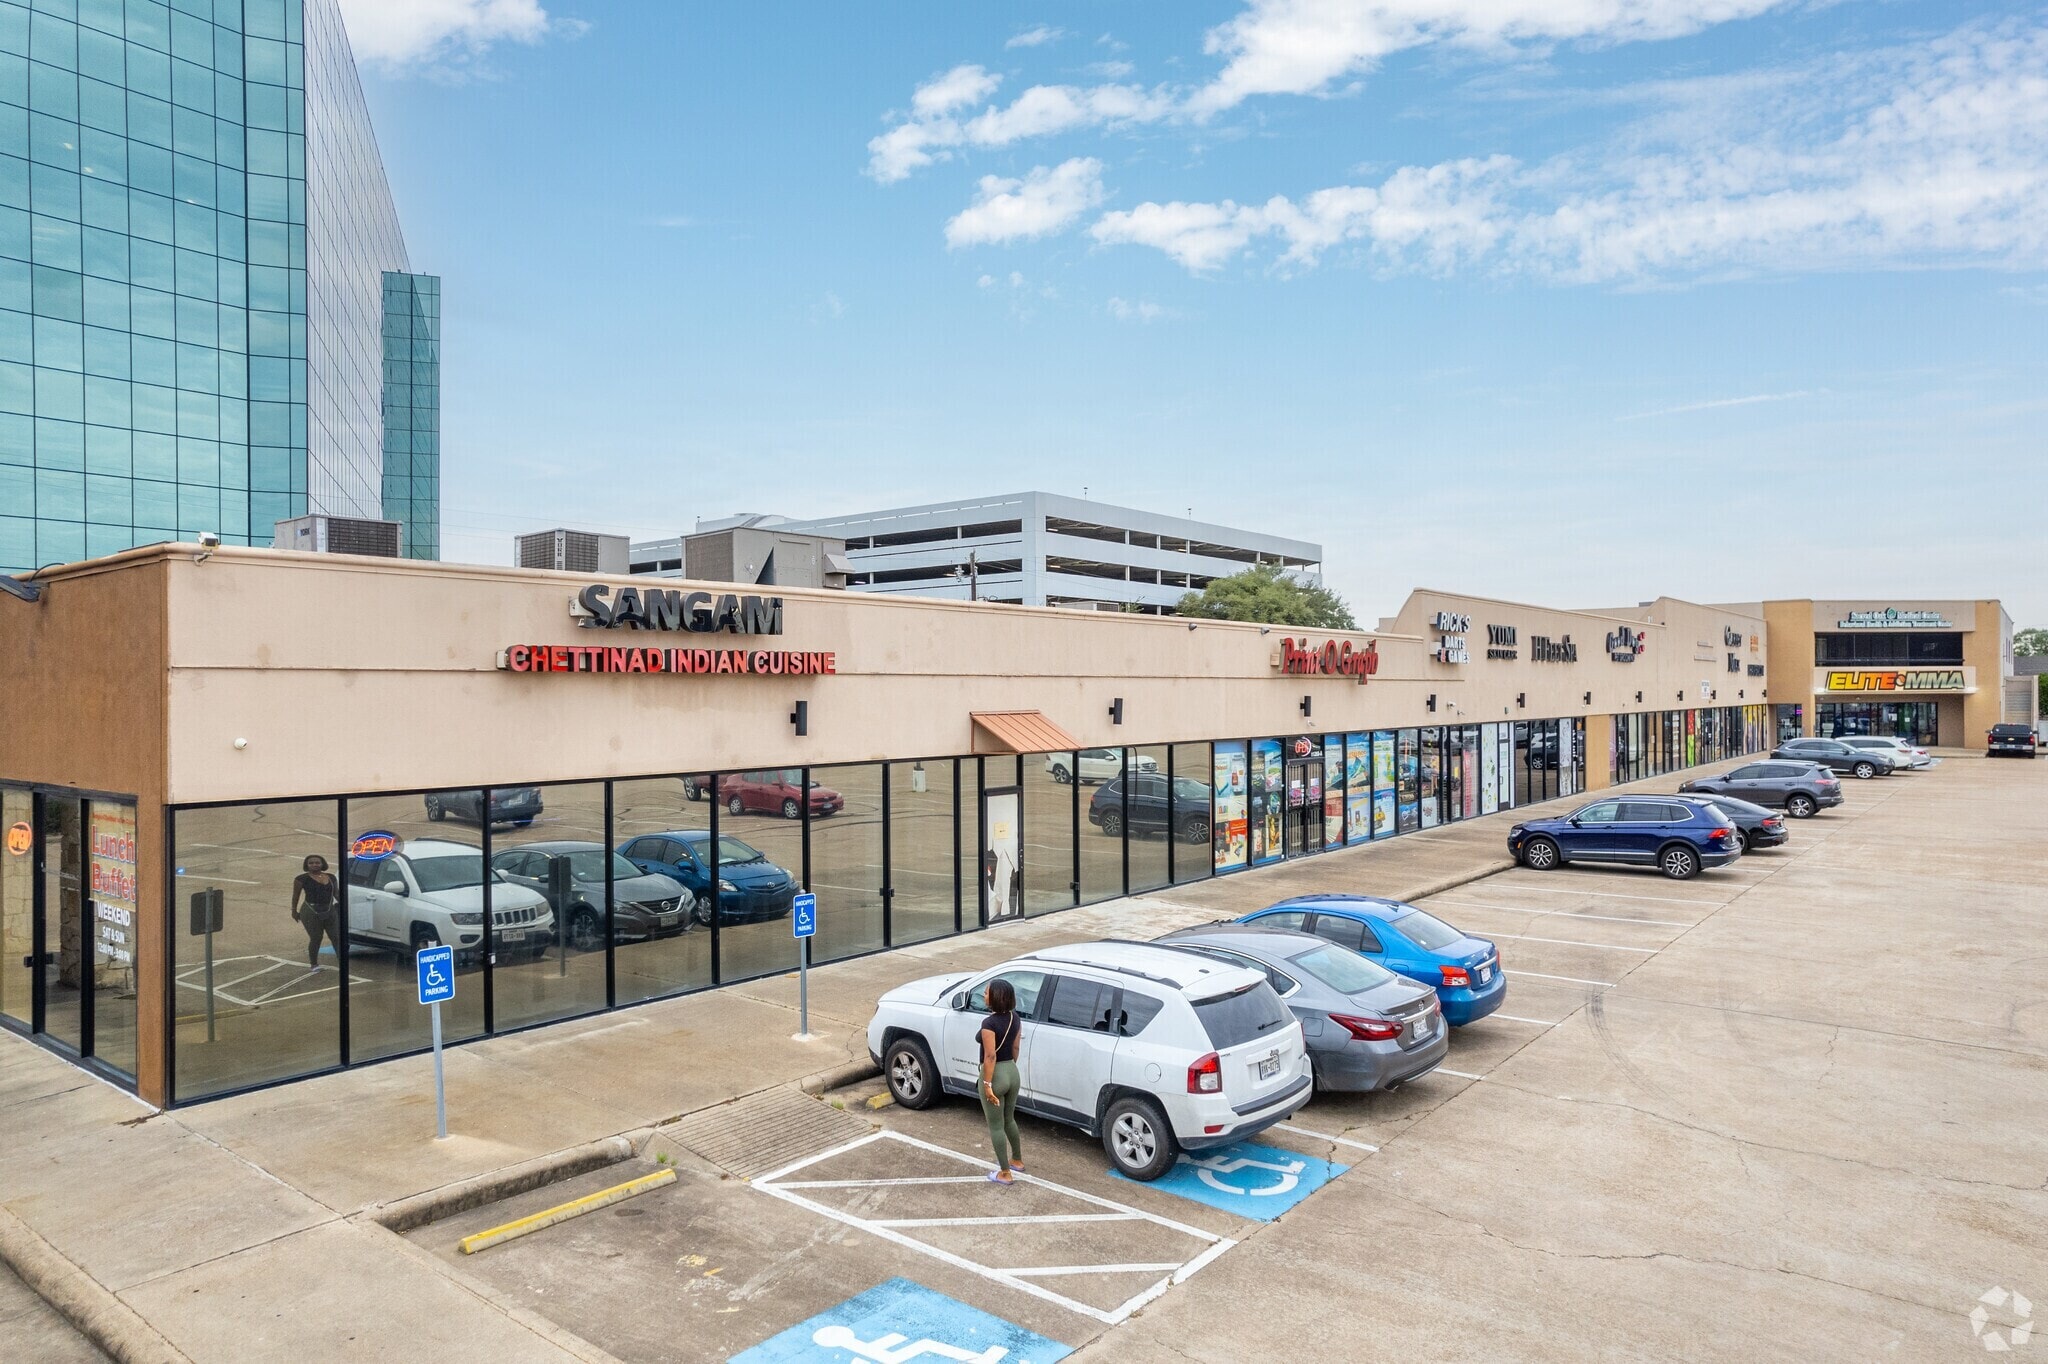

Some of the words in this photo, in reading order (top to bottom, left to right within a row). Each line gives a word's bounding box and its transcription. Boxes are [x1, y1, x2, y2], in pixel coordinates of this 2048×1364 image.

[578, 584, 783, 635] SANGAM
[1443, 635, 1466, 649] DARTS
[1487, 624, 1517, 646] YUMI
[506, 644, 664, 673] CHETTINAD
[666, 648, 749, 674] INDIAN
[752, 650, 836, 675] CUISINE
[1280, 637, 1321, 675] Print
[1323, 640, 1337, 675] O
[1340, 639, 1379, 685] Graph
[1448, 649, 1471, 664] GAMES
[1828, 671, 1897, 690] ELITE
[1904, 671, 1965, 690] MMA
[92, 825, 135, 863] Lunch
[351, 837, 396, 856] OPEN
[92, 861, 136, 903] Buffet
[98, 901, 131, 927] WEEKEND
[102, 926, 111, 940] SAT
[420, 952, 450, 963] HANDICAPPED
[425, 985, 448, 996] PARKING
